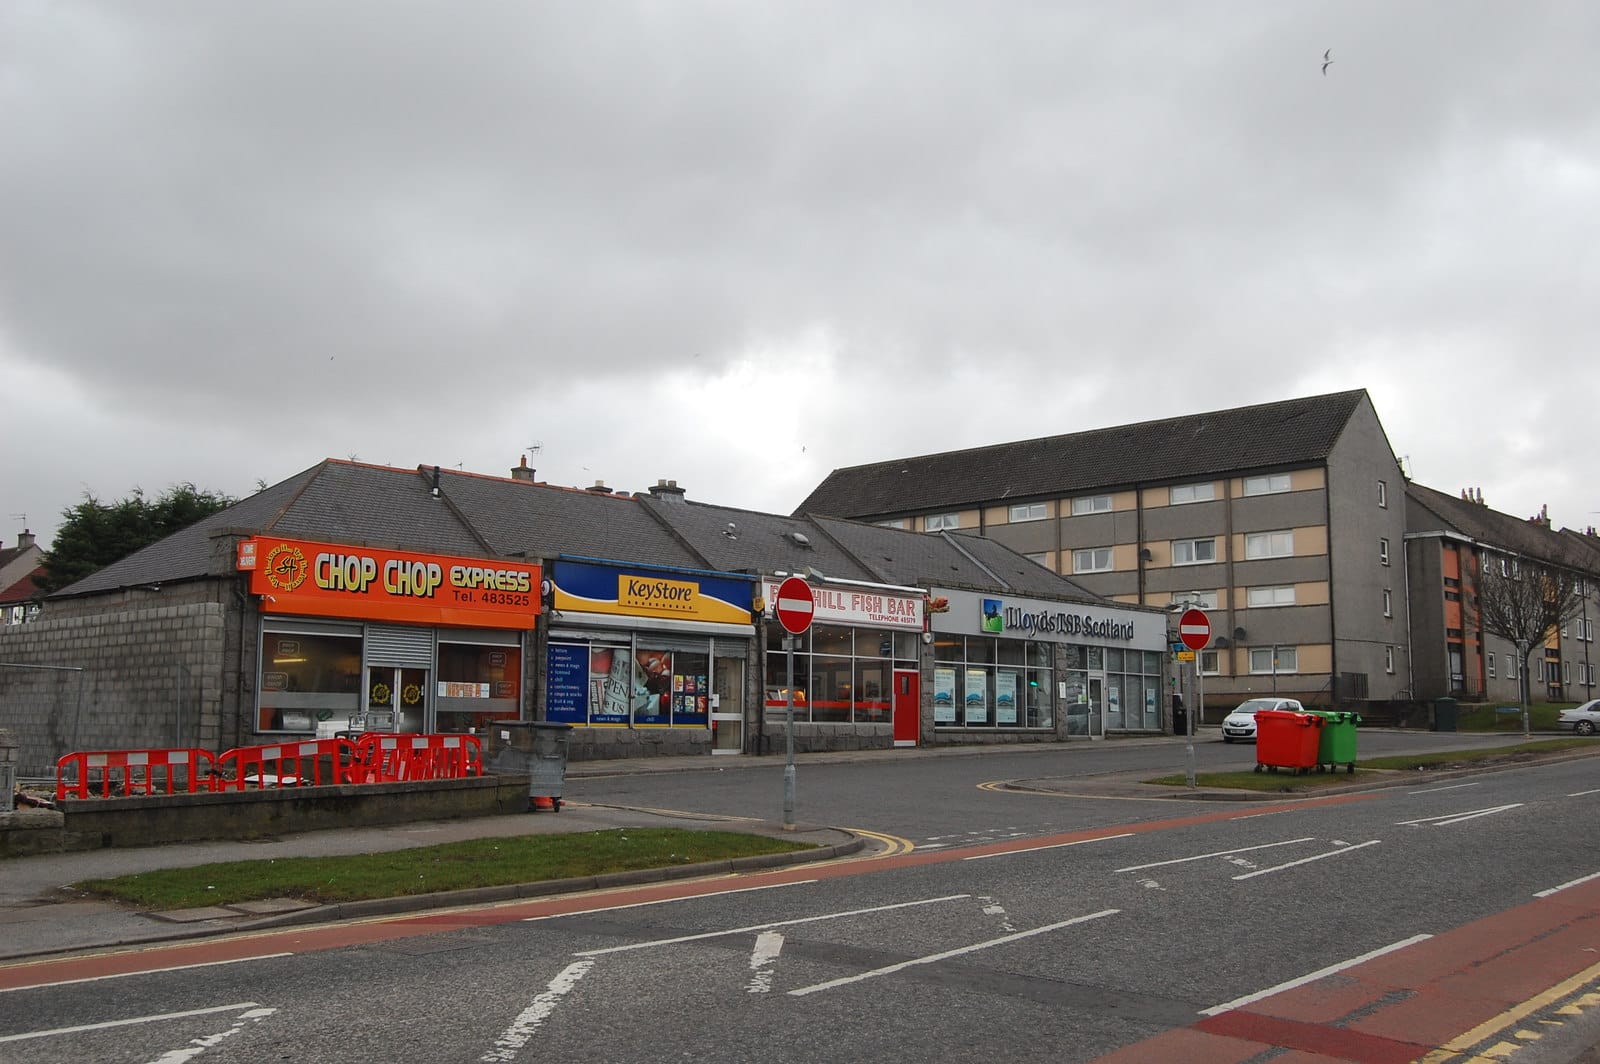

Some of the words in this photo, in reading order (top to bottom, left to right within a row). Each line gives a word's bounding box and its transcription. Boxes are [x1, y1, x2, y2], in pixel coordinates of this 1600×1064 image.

[315, 552, 377, 593] CHOP
[383, 560, 443, 597] CHOP
[450, 565, 531, 592] EXPRESS
[452, 590, 477, 603] Tel.
[481, 593, 530, 607] 483525
[627, 579, 692, 601] KeyStore
[851, 594, 882, 614] FISH
[887, 597, 916, 617] BAR
[869, 613, 899, 623] TELEPHONE
[1005, 607, 1055, 638] Lloyds
[1056, 613, 1081, 635] TSB
[1082, 615, 1134, 640] Scotland
[612, 701, 625, 714] US
